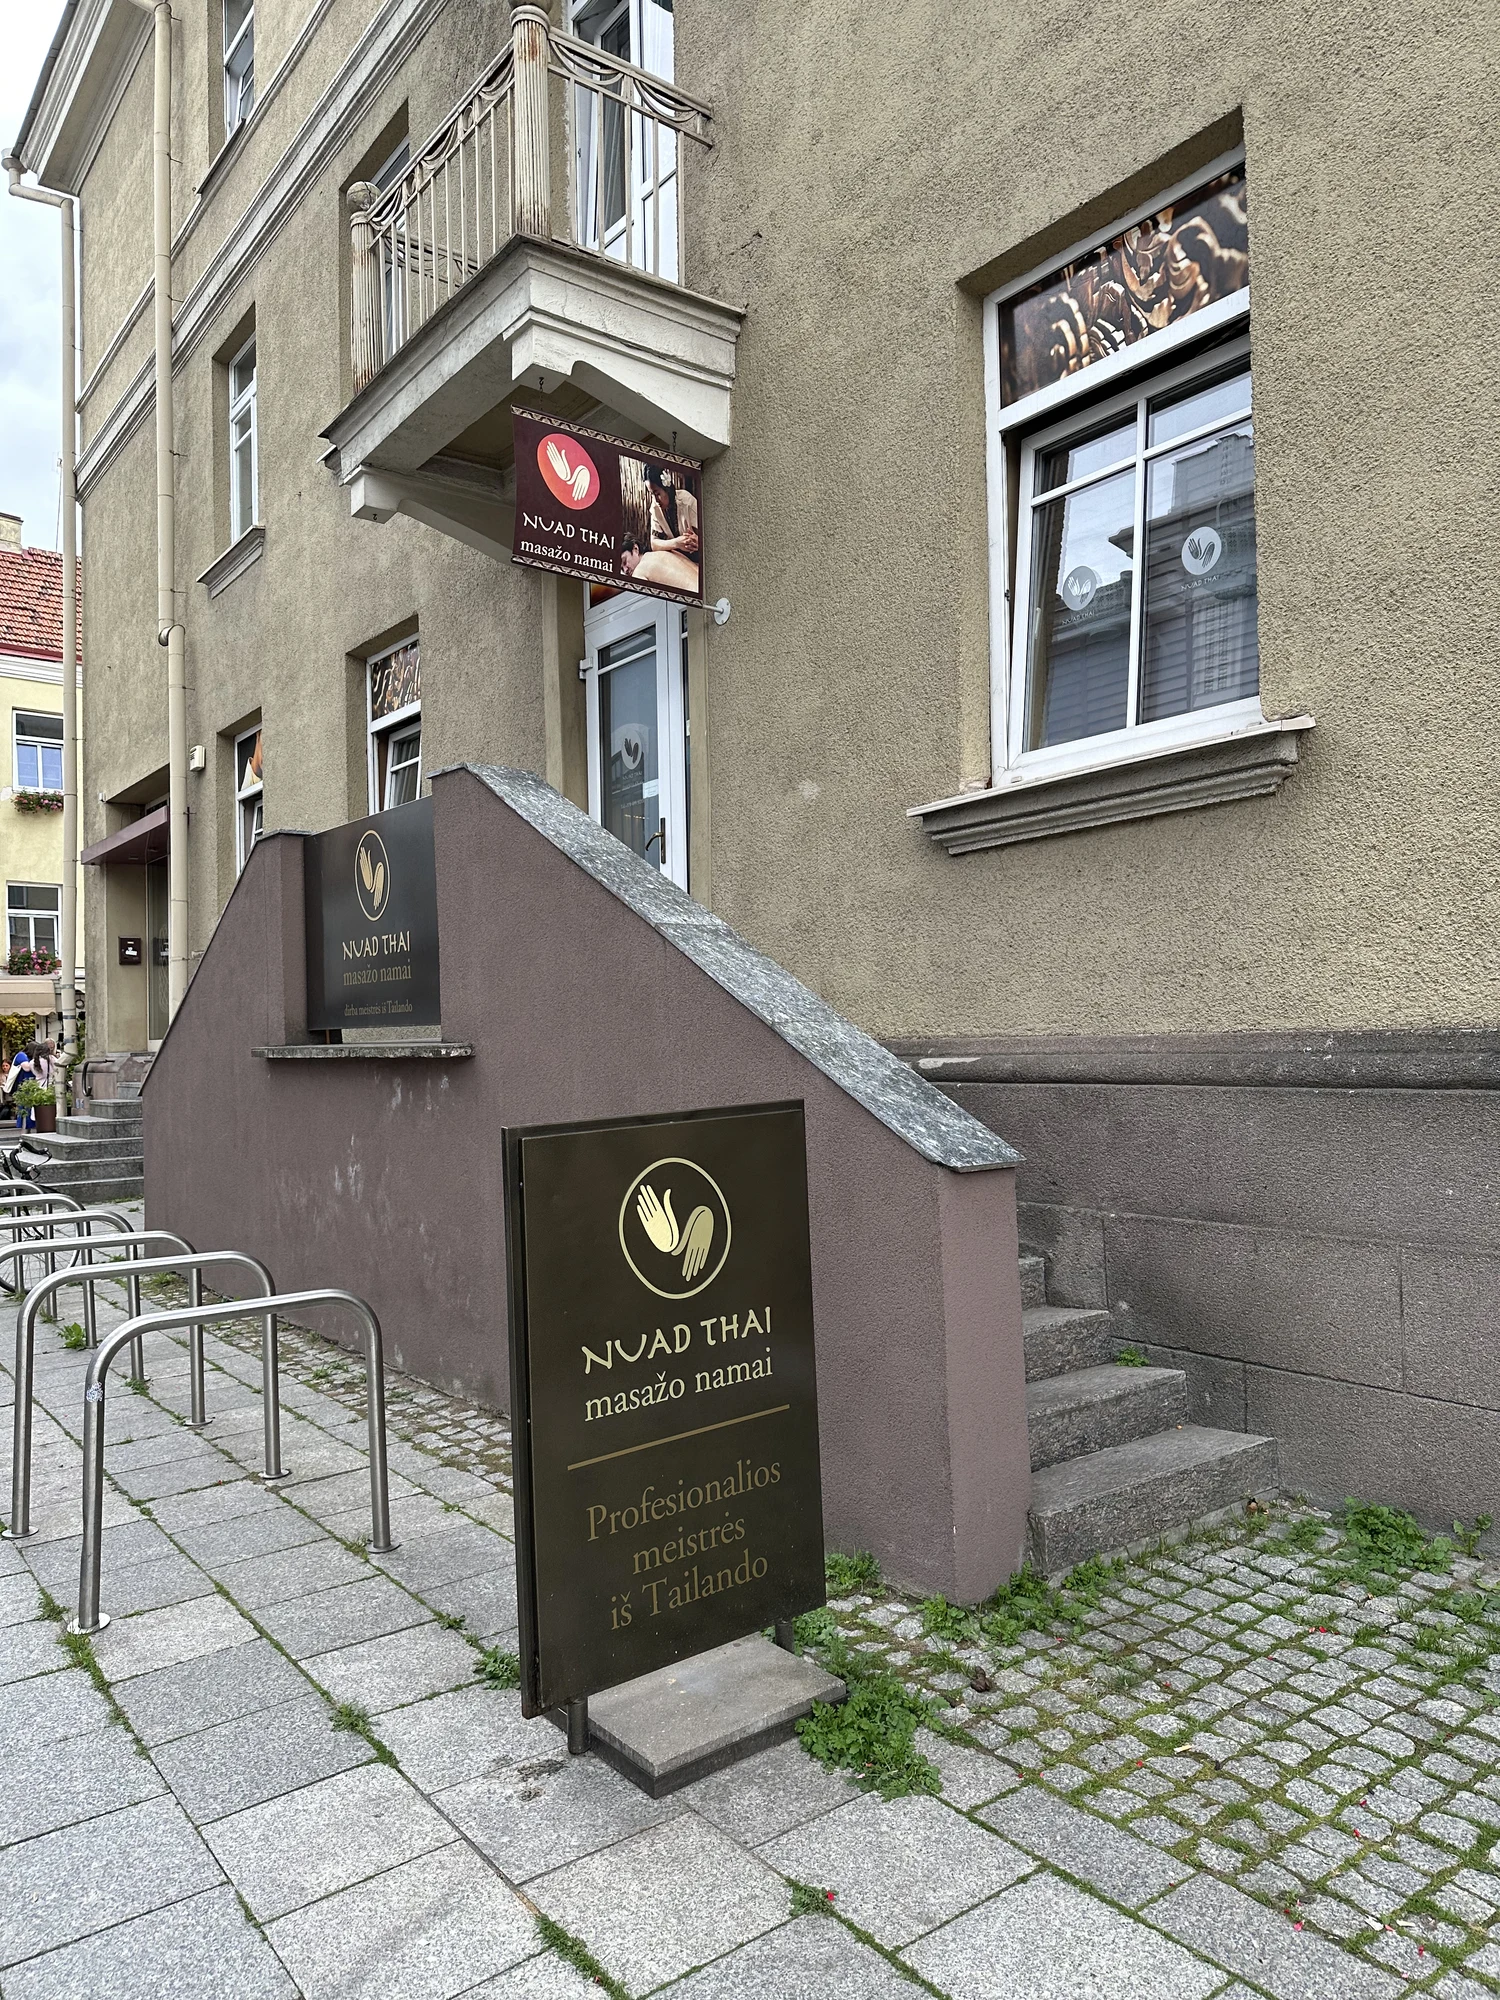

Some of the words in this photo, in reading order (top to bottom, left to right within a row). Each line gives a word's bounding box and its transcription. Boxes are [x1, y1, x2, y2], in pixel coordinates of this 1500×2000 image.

[522, 512, 575, 538] NUAD
[580, 528, 614, 549] THAI
[520, 541, 571, 562] masažo
[574, 554, 613, 573] namai
[342, 936, 379, 960] NUAD
[382, 930, 411, 955] THAI
[343, 963, 378, 986] masažo
[380, 958, 412, 982] namai
[344, 1004, 358, 1016] dirba
[387, 999, 413, 1014] Tailando
[581, 1323, 691, 1374] NUAD
[700, 1306, 771, 1346] THAI
[584, 1371, 685, 1422] masažo
[694, 1347, 773, 1393] namai
[586, 1459, 781, 1542] Profesionalios
[632, 1511, 746, 1575] meistrės
[611, 1591, 632, 1630] iš
[641, 1548, 768, 1617] Tailando
